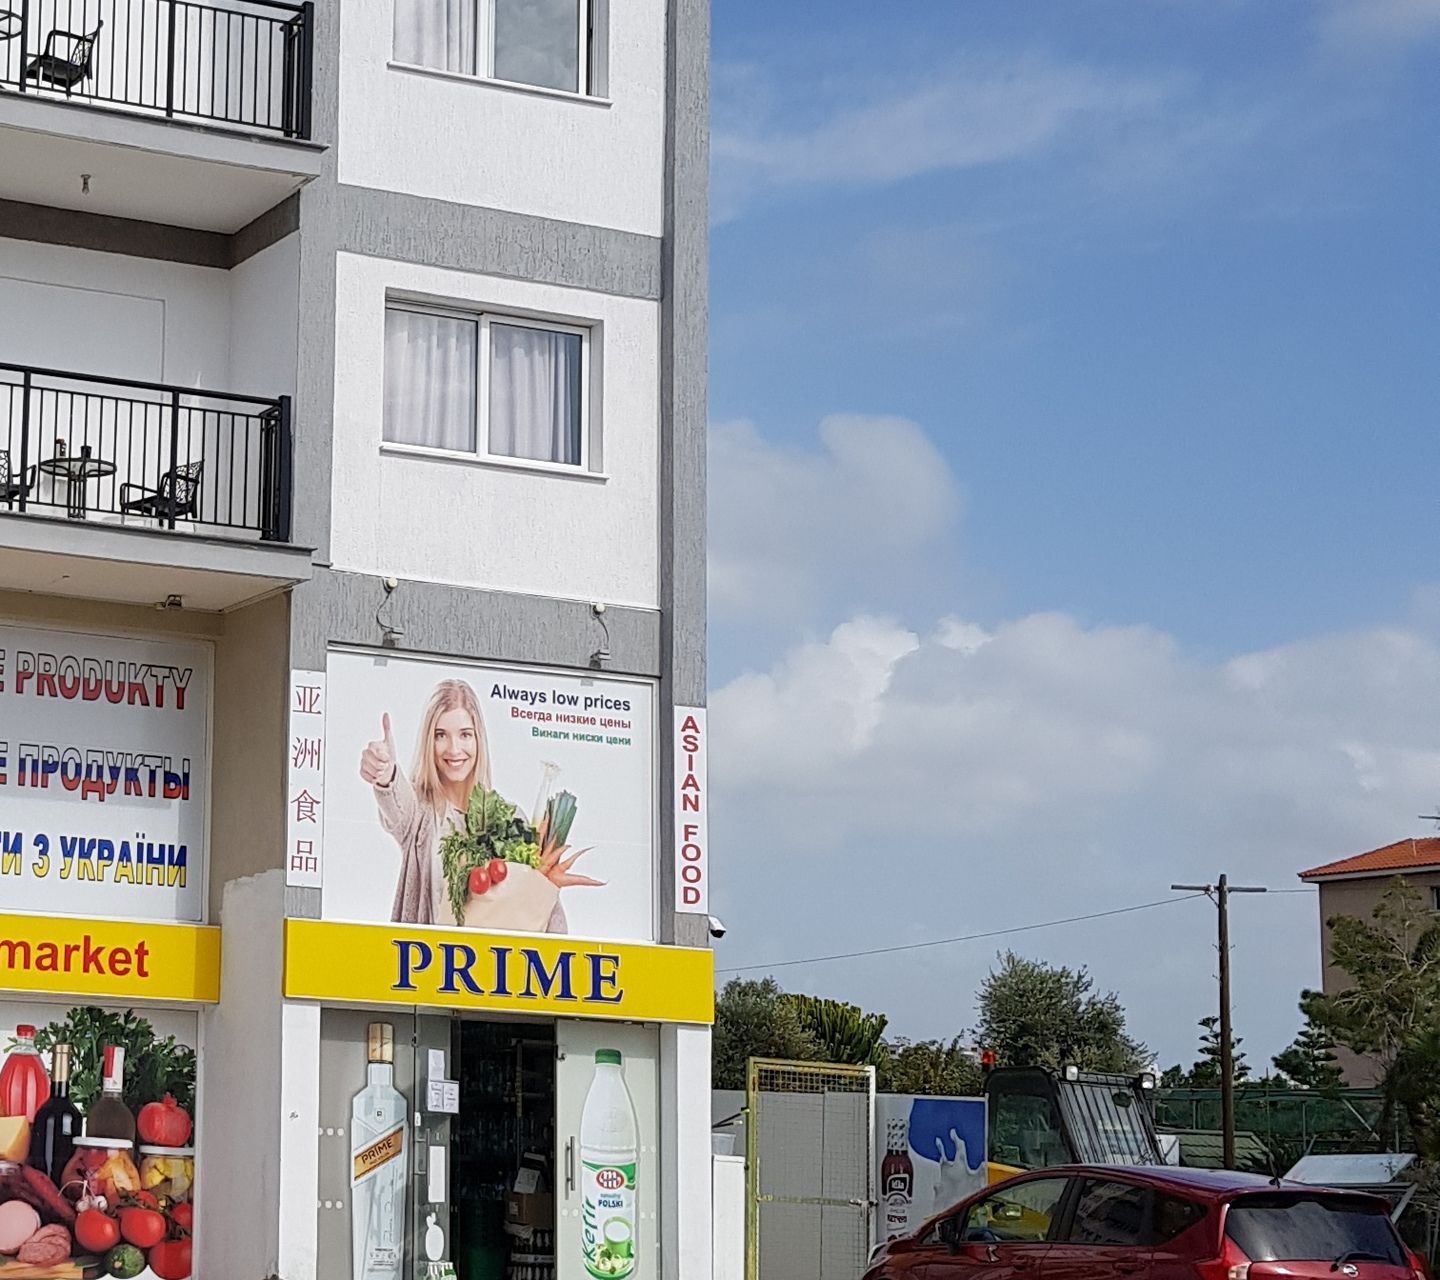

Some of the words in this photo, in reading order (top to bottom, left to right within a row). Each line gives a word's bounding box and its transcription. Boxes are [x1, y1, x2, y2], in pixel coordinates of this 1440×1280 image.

[15, 651, 193, 710] PRODUKTY
[490, 684, 547, 705] Always
[552, 690, 579, 706] low
[584, 695, 631, 711] prices
[511, 707, 552, 722] Всегда
[555, 715, 596, 726] низкие
[600, 718, 631, 729] цены
[532, 726, 569, 740] Винаги
[606, 736, 631, 746] цени
[17, 743, 191, 802] ПРОДУКТЫ
[291, 684, 322, 873] 亚洲食品
[681, 715, 701, 812] ASIAN
[59, 832, 188, 888] УКРАЇНИ
[681, 824, 702, 905] FOOD
[391, 939, 624, 1004] PRIME
[361, 1138, 394, 1165] PRIME
[598, 1200, 624, 1208] POLSKI
